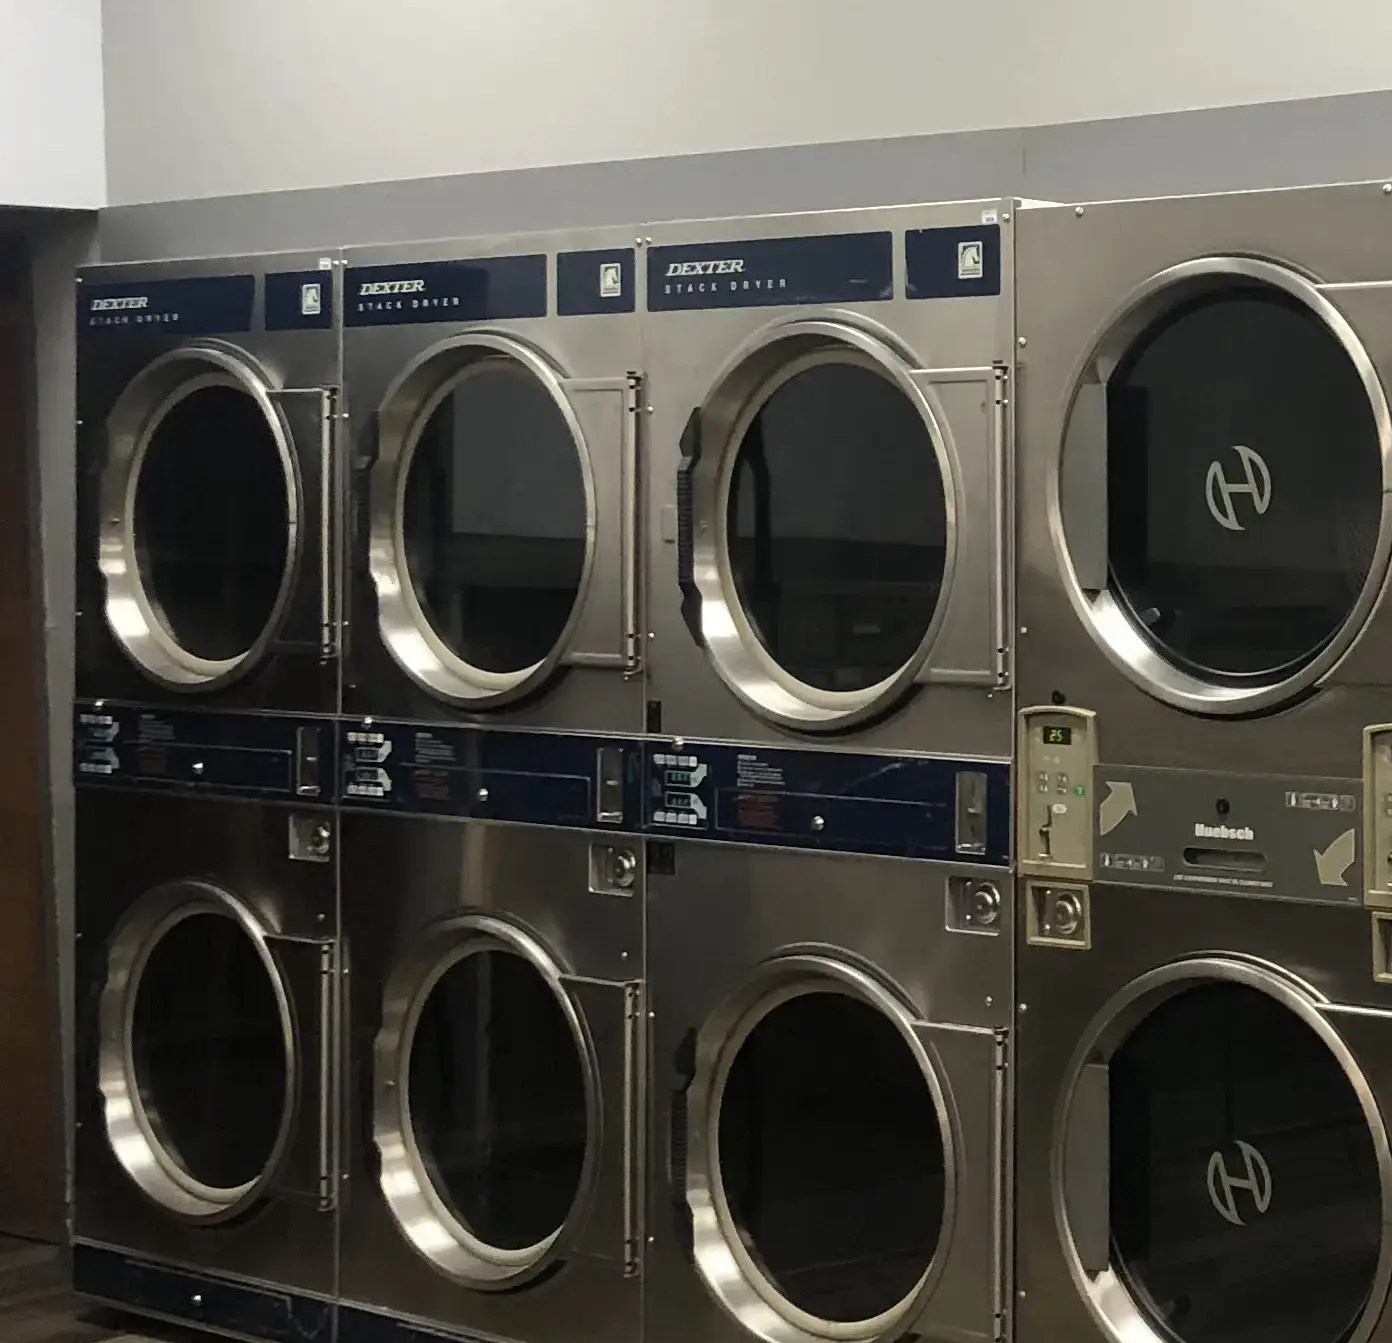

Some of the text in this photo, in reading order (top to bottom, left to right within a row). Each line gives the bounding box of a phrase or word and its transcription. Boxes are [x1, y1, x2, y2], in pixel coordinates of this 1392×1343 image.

[665, 259, 745, 276] DEXTER
[358, 280, 425, 295] DEXTER
[665, 279, 786, 294] STACK DRYER
[91, 297, 148, 310] DEXTER
[1048, 729, 1063, 742] 25
[1195, 823, 1254, 840] Huebsch
